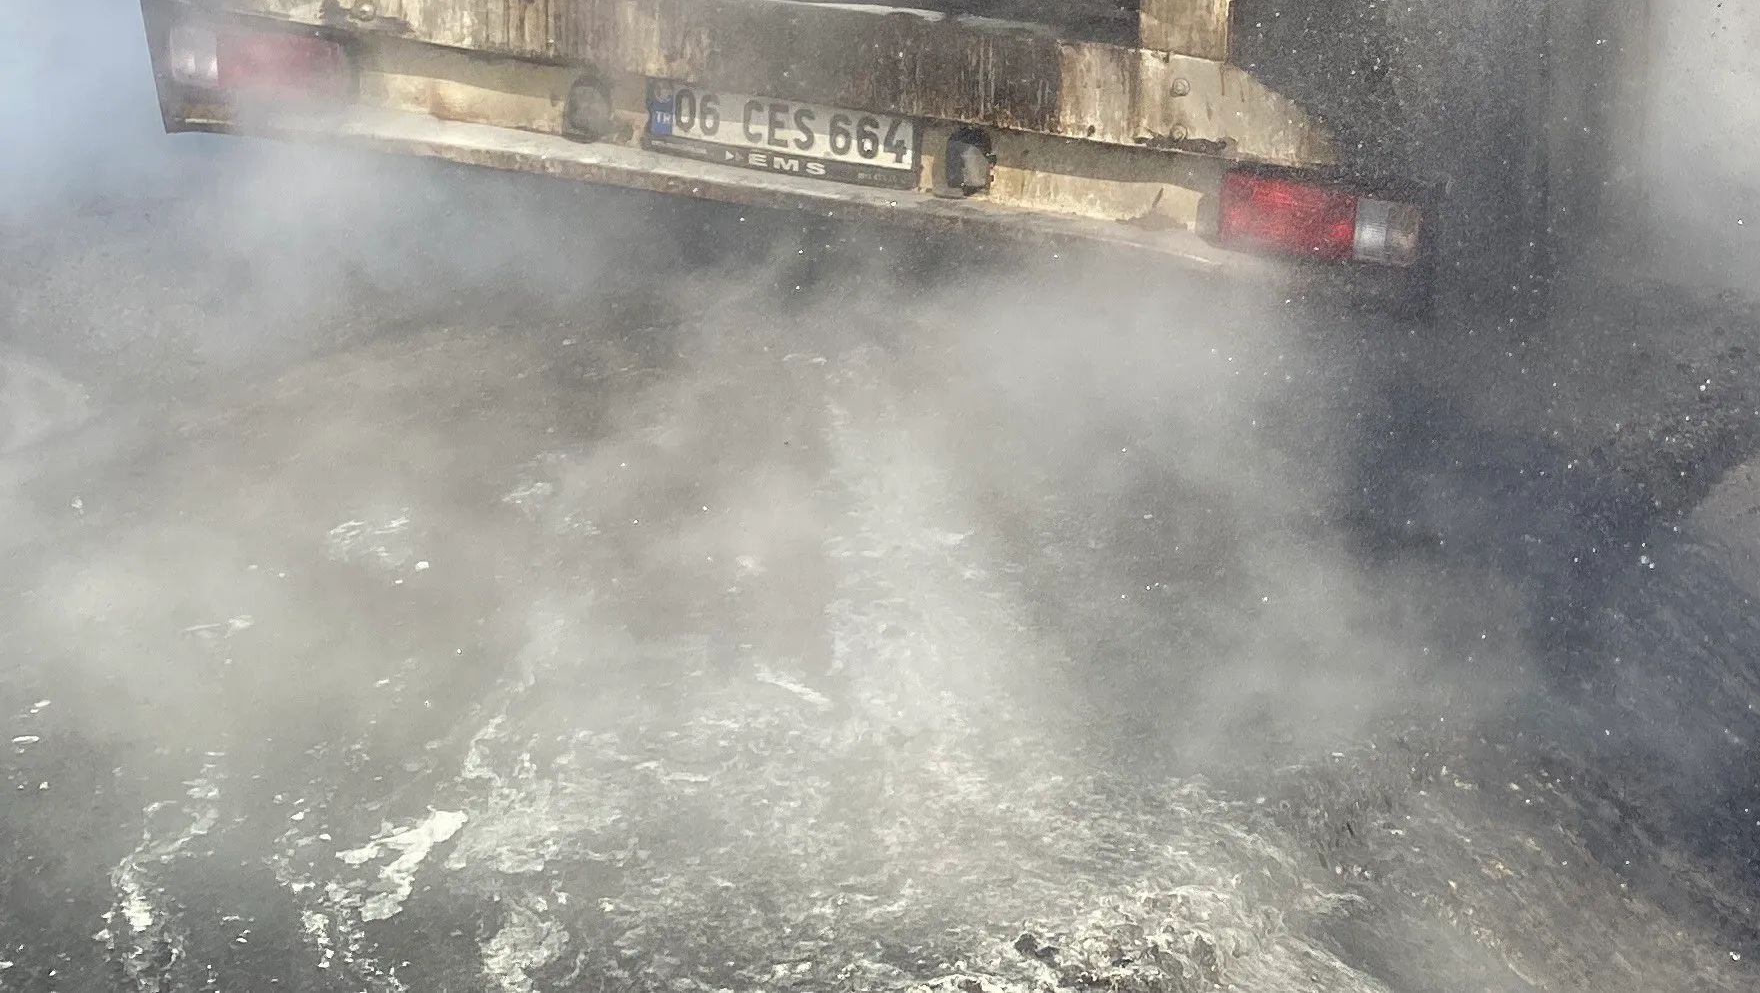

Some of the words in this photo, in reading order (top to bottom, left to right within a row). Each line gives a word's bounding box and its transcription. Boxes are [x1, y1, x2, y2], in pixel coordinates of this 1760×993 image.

[675, 88, 720, 136] 06
[743, 99, 815, 151] CES
[829, 113, 908, 164] 664
[748, 153, 826, 176] EMS
